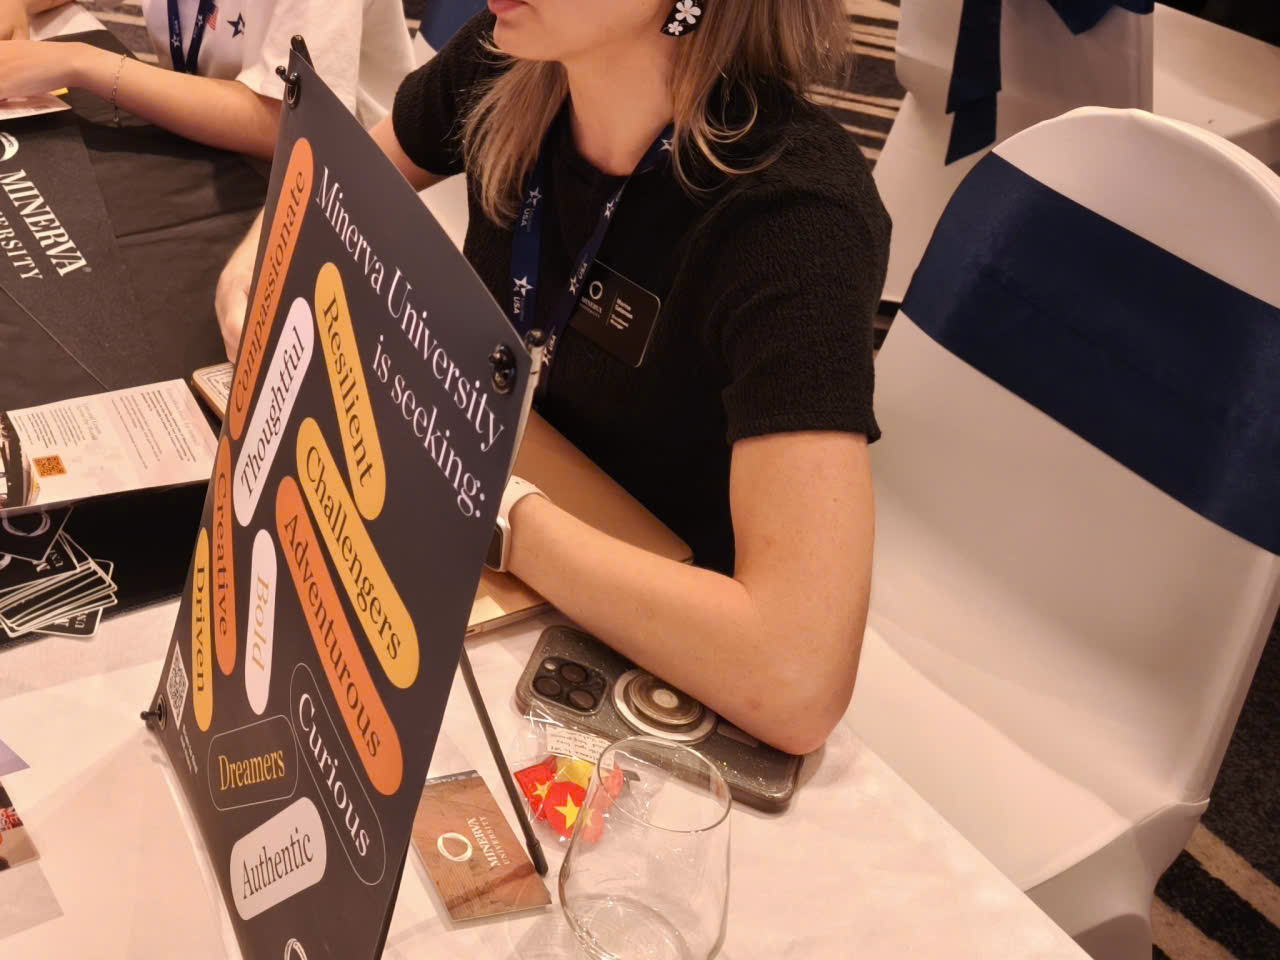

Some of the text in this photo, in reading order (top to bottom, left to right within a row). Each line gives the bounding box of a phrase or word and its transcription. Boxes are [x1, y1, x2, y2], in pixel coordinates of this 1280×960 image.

[234, 170, 306, 414] Compassionate
[315, 165, 505, 453] Minerva University
[239, 325, 306, 498] Thoughtful
[323, 291, 375, 489] Resilient
[373, 334, 486, 519] is seeking:
[195, 566, 206, 693] Driven
[215, 471, 229, 637] Creative
[251, 575, 269, 672] Bold
[283, 513, 382, 760] Adventurous
[306, 446, 403, 662] Challengers
[218, 749, 286, 792] Dreamers
[298, 692, 371, 858] Curious
[467, 817, 500, 868] MINERVA
[242, 826, 314, 900] Authentic
